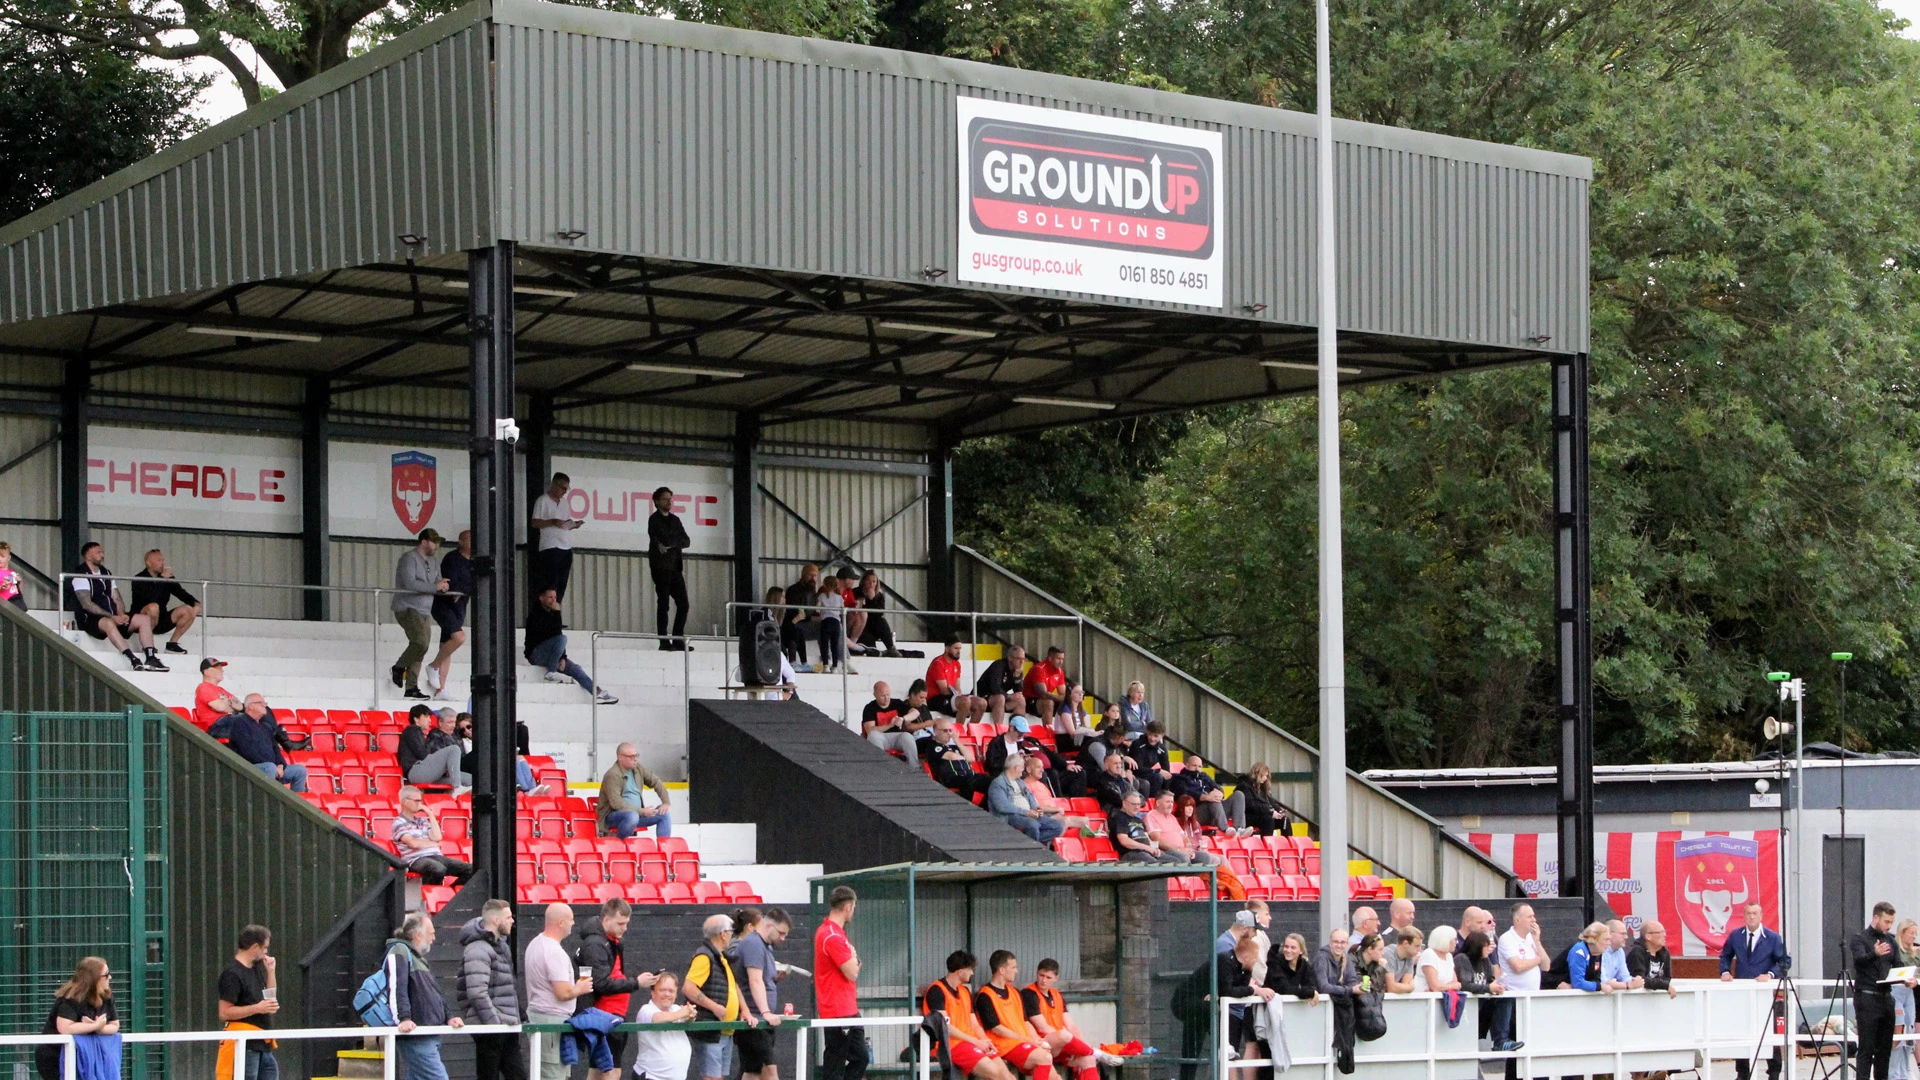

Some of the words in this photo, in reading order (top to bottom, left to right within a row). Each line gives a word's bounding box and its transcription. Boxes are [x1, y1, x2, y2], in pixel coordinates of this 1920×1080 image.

[1017, 209, 1166, 240] SOLUTIONS
[972, 252, 1083, 276] gusgroup.co.uk
[1119, 264, 1146, 283] 0161
[1150, 267, 1175, 286] 850
[1179, 271, 1208, 290] 4851
[566, 488, 654, 523] OWN
[1680, 842, 1713, 853] CHEADLE
[1719, 842, 1741, 850] TOWN
